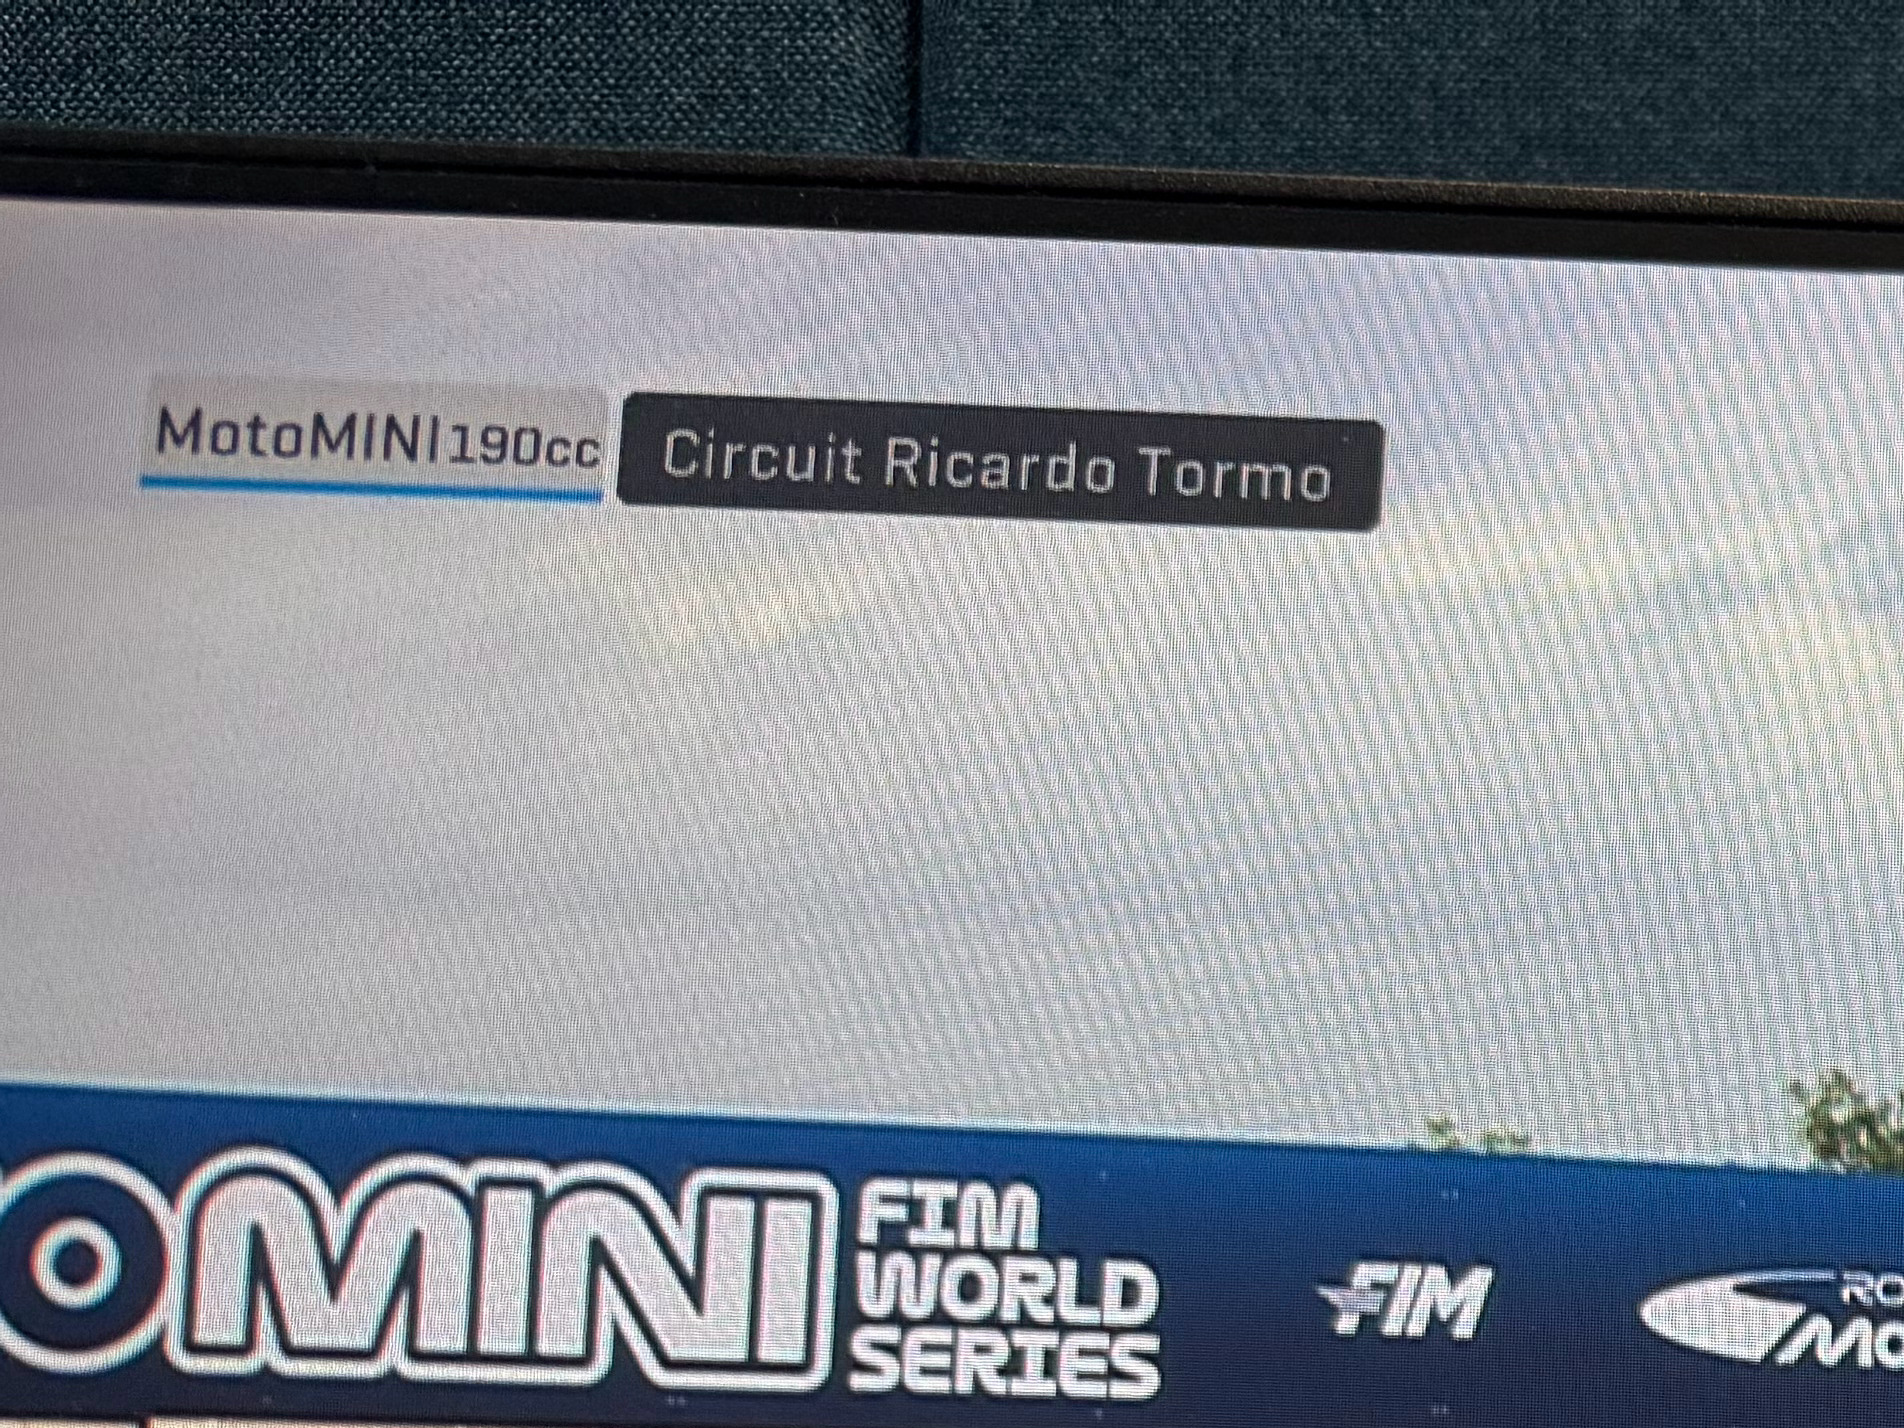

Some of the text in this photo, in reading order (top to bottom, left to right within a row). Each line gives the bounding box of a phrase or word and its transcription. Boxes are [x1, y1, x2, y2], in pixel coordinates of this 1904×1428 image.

[661, 426, 1334, 504] Circuit Ricardo Tormo
[856, 1174, 1043, 1252] FIM
[854, 1250, 1162, 1328] WORLD
[1325, 1261, 1494, 1341] FIM
[847, 1325, 1162, 1400] SERIES
